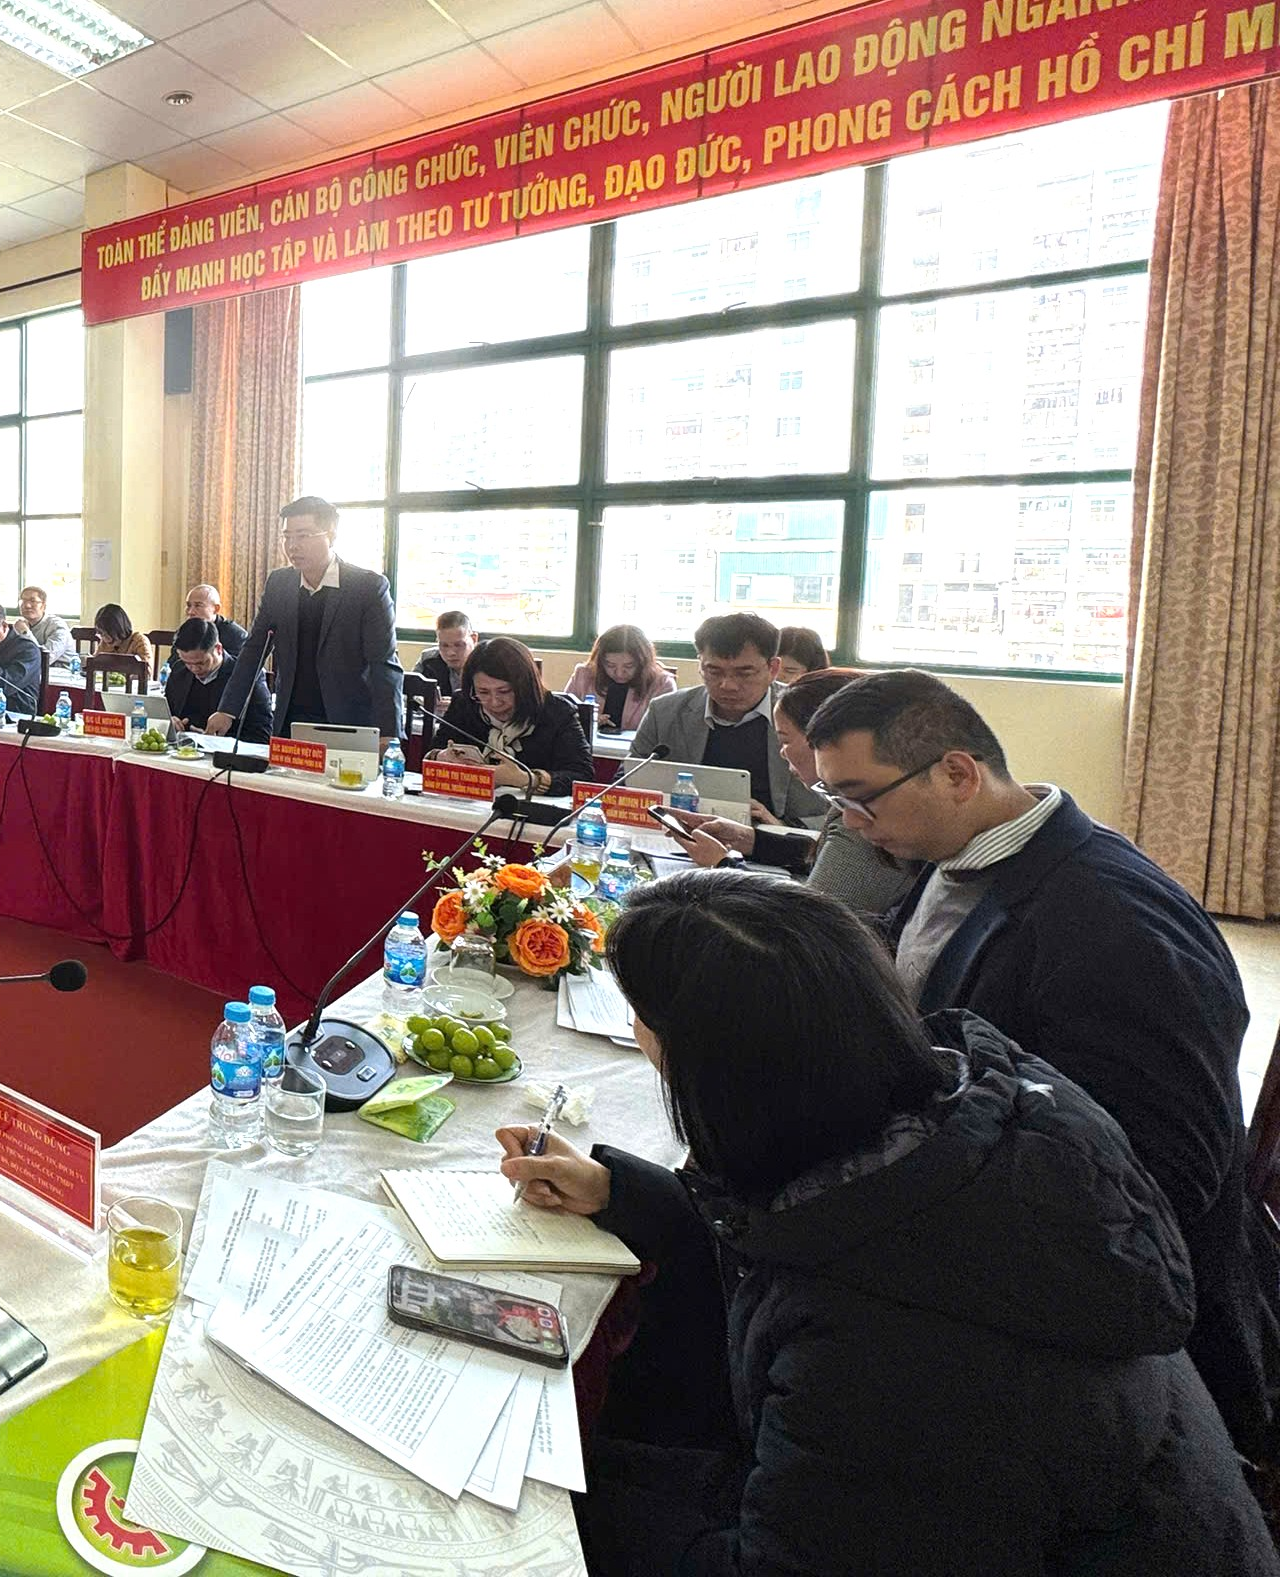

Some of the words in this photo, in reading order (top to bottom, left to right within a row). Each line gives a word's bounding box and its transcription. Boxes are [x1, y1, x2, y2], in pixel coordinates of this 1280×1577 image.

[97, 237, 135, 270] TOÀN
[138, 219, 167, 260] THỂ
[169, 214, 215, 252] ĐẢNG
[219, 203, 265, 240] VIÊN,
[270, 190, 309, 227] CÁN
[315, 176, 343, 218] BỘ
[348, 164, 409, 207] CÔNG
[415, 143, 487, 190] CHỨC,
[494, 126, 555, 170] VIÊN
[563, 98, 651, 151] CHỨC,
[660, 61, 763, 128] NGƯỜI
[774, 44, 841, 98] LAO
[853, 8, 968, 77] ĐỘNG
[141, 262, 172, 301] ĐẨY
[175, 259, 225, 296] MẠNH
[229, 249, 266, 285] HỌC
[271, 236, 307, 276] TẬP
[312, 226, 338, 264] VÀ
[343, 219, 390, 258] LÀM
[396, 205, 454, 246] THEO
[460, 192, 495, 232] TƯ
[498, 171, 595, 223] TƯỞNG,
[604, 154, 666, 202] ĐẠO
[675, 132, 752, 185] ĐỨC,
[763, 99, 893, 165] PHONG
[906, 65, 1023, 131] CÁCH
[1037, 31, 1102, 103] HỒ
[1118, 9, 1208, 83] CHÍ
[1223, 2, 1280, 59] M
[11, 1117, 42, 1141] TRUNG
